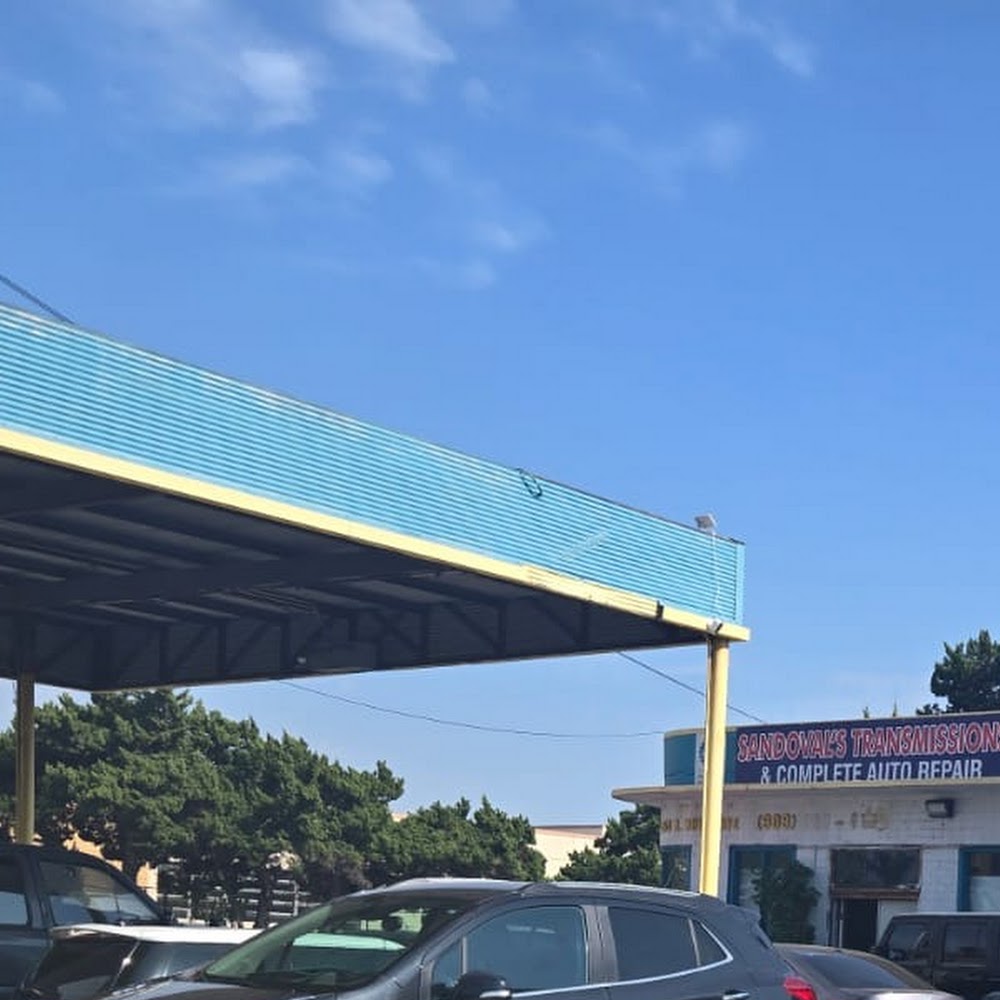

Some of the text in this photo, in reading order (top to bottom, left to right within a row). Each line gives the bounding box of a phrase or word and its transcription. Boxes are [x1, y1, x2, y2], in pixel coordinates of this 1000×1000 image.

[738, 729, 847, 762] SANDOVAL'S
[760, 759, 983, 784] & COMPLETE AUTO REPAIR
